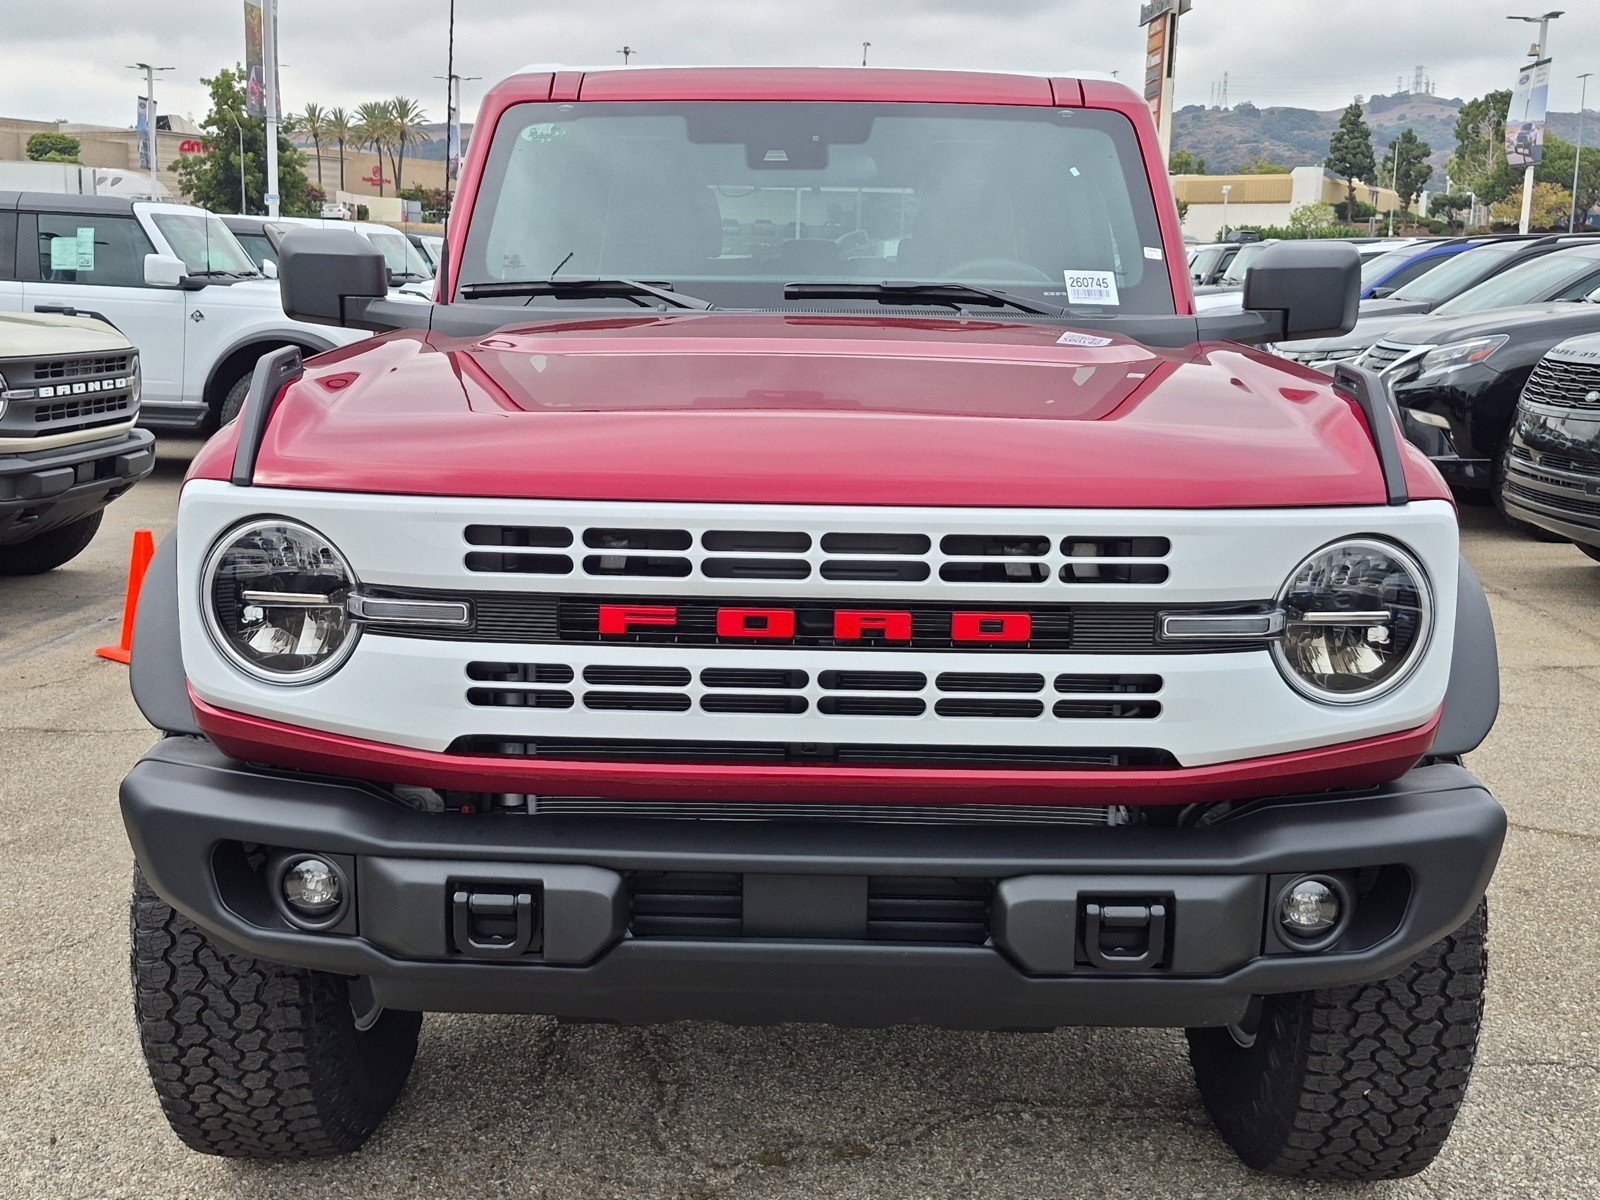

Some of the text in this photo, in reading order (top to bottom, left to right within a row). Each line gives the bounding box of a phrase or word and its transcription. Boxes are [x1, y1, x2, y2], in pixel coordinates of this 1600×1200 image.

[1069, 276, 1109, 289] 260745
[39, 378, 127, 398] BRONCO
[598, 604, 1031, 643] FORD
